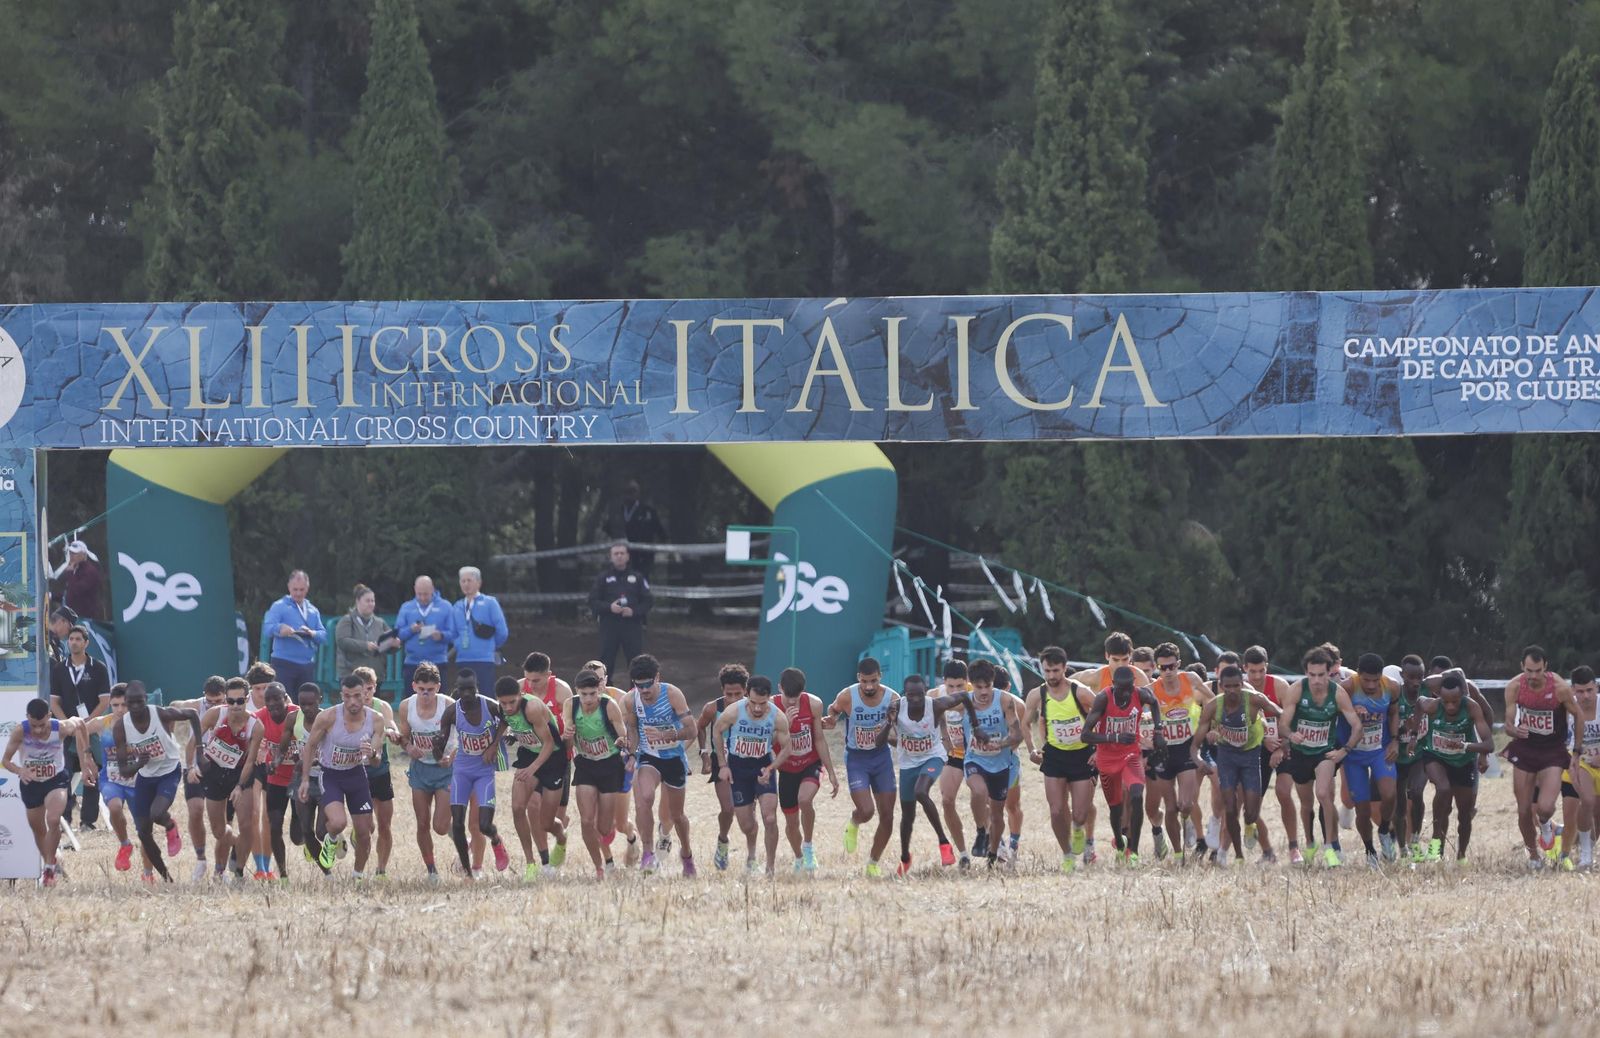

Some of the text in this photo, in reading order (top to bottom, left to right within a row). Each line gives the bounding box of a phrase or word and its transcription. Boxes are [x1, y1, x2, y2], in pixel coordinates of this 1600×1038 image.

[1343, 335, 1521, 358] CAMPEONATO
[1526, 335, 1558, 355] DE
[668, 297, 1168, 414] ITÁLICA
[101, 323, 572, 411] XLIII CROSS
[1402, 359, 1435, 380] DE
[1439, 358, 1534, 380] CAMPO
[1538, 358, 1559, 378] A
[370, 379, 648, 409] INTERNACIONAL
[1460, 380, 1600, 402] POR CLUBES
[100, 415, 599, 444] INTERNATIONAL CROSS COUNTRY
[739, 724, 770, 736] nerja
[973, 718, 1000, 728] erja
[1523, 715, 1552, 730] ARCE
[1056, 728, 1082, 738] 5126
[1163, 723, 1191, 740] ALBA
[1300, 729, 1328, 742] MARTIN
[463, 735, 491, 751] KIBET
[735, 742, 766, 756] AOUINA
[901, 738, 932, 751] KOECH
[209, 745, 236, 765] 5102
